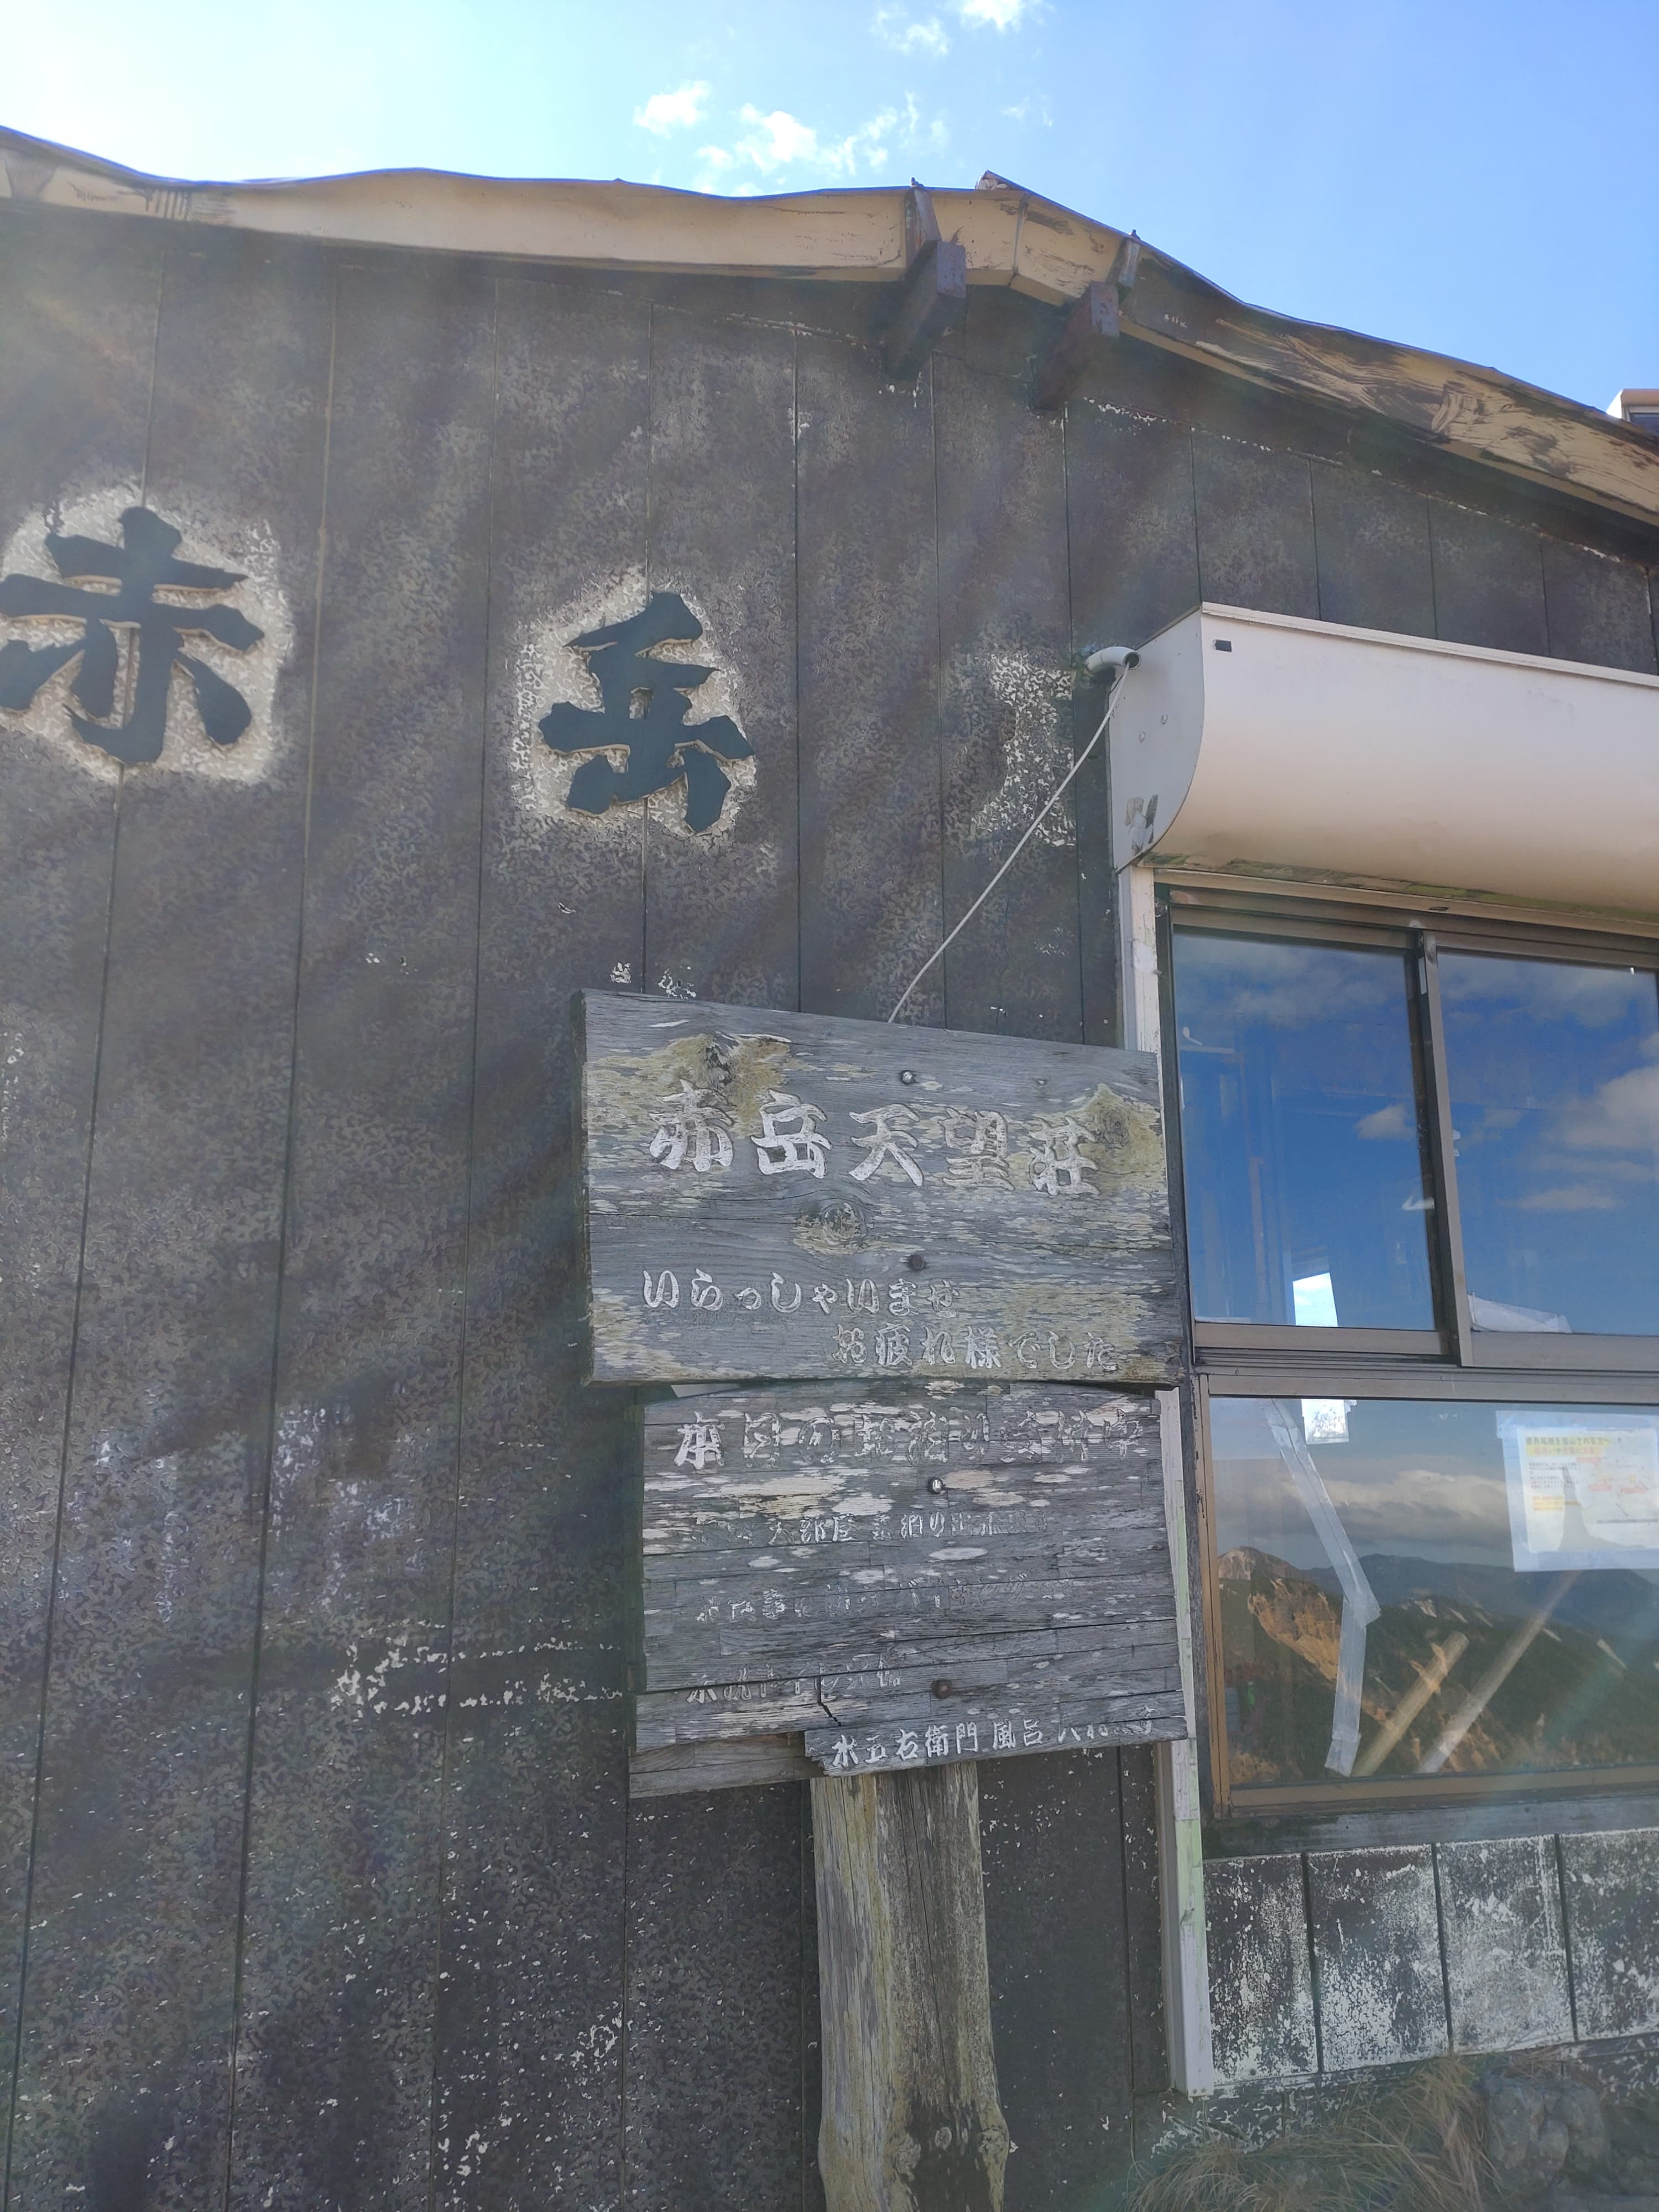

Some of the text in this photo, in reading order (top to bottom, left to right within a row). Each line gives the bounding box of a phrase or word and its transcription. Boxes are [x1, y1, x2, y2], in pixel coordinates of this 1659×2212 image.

[648, 1078, 1100, 1197] 赤岳天望荘
[643, 1267, 960, 1317] いらっしゃいませ
[831, 1323, 1118, 1370] お疲れ様でした
